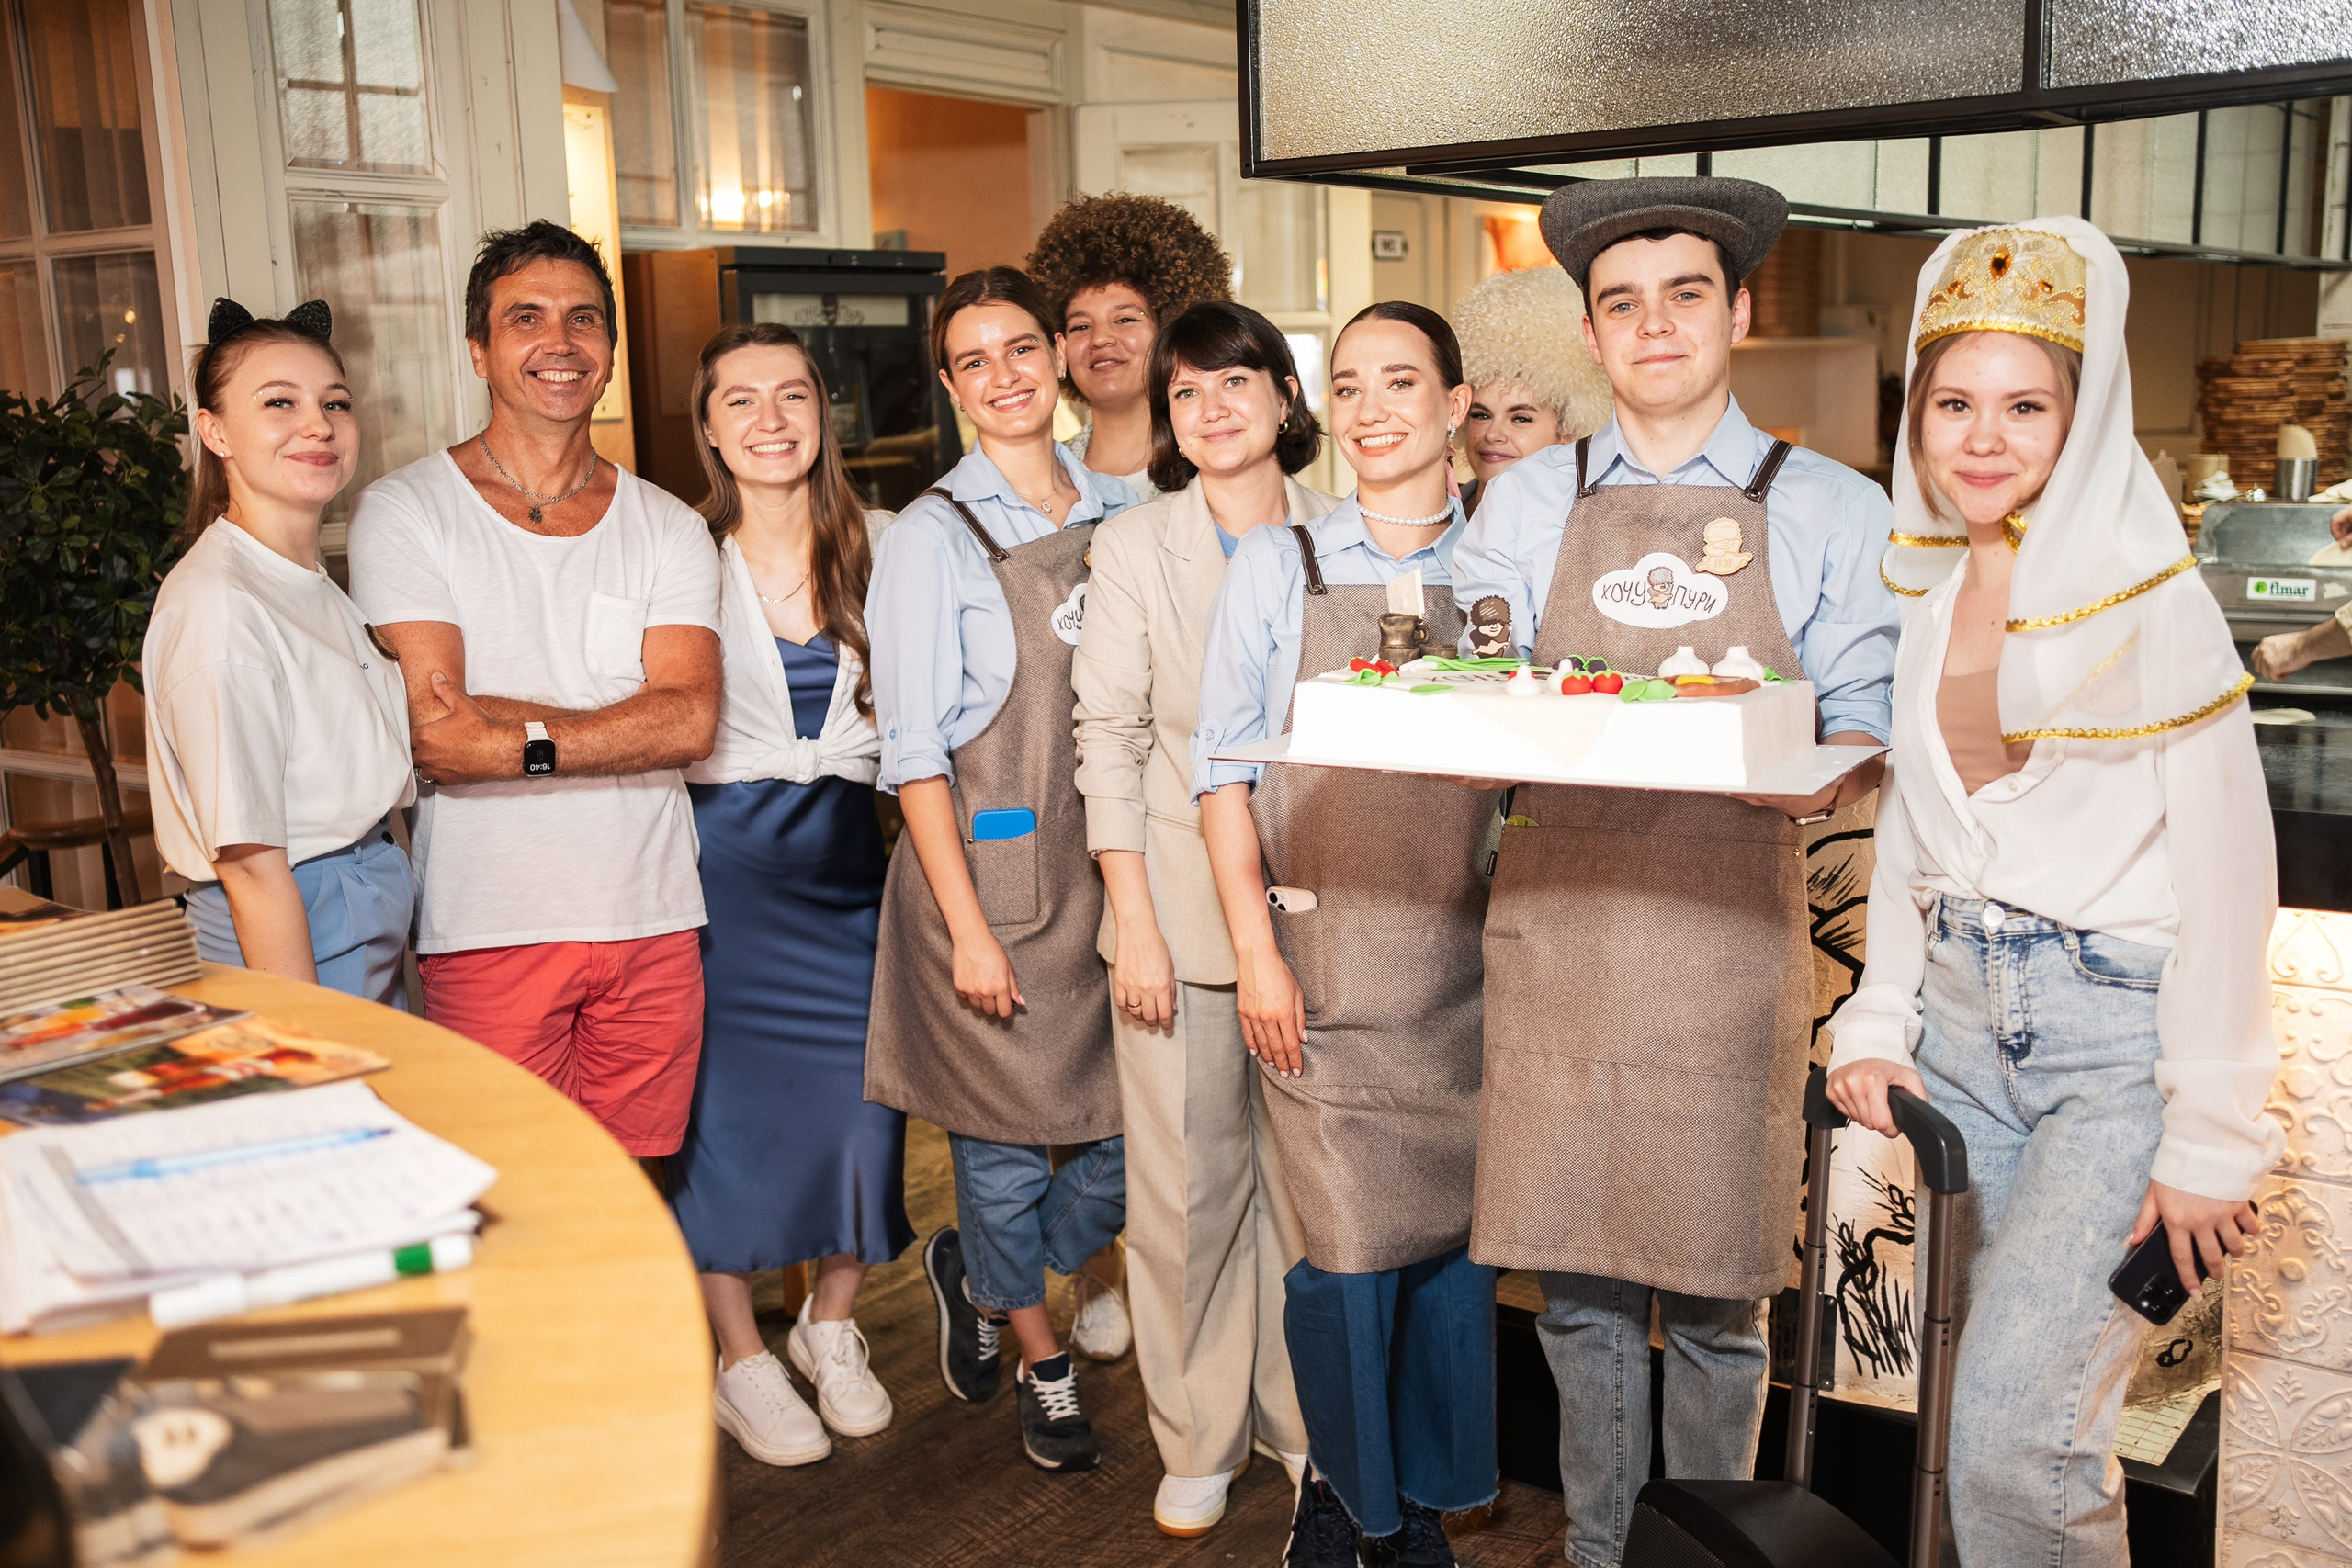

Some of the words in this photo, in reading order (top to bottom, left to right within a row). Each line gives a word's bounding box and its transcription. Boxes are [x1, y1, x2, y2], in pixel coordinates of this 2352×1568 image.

[1600, 581, 1647, 607] ХОЧУ
[1671, 585, 1717, 614] ПУРИ
[529, 762, 551, 772] 16:40
